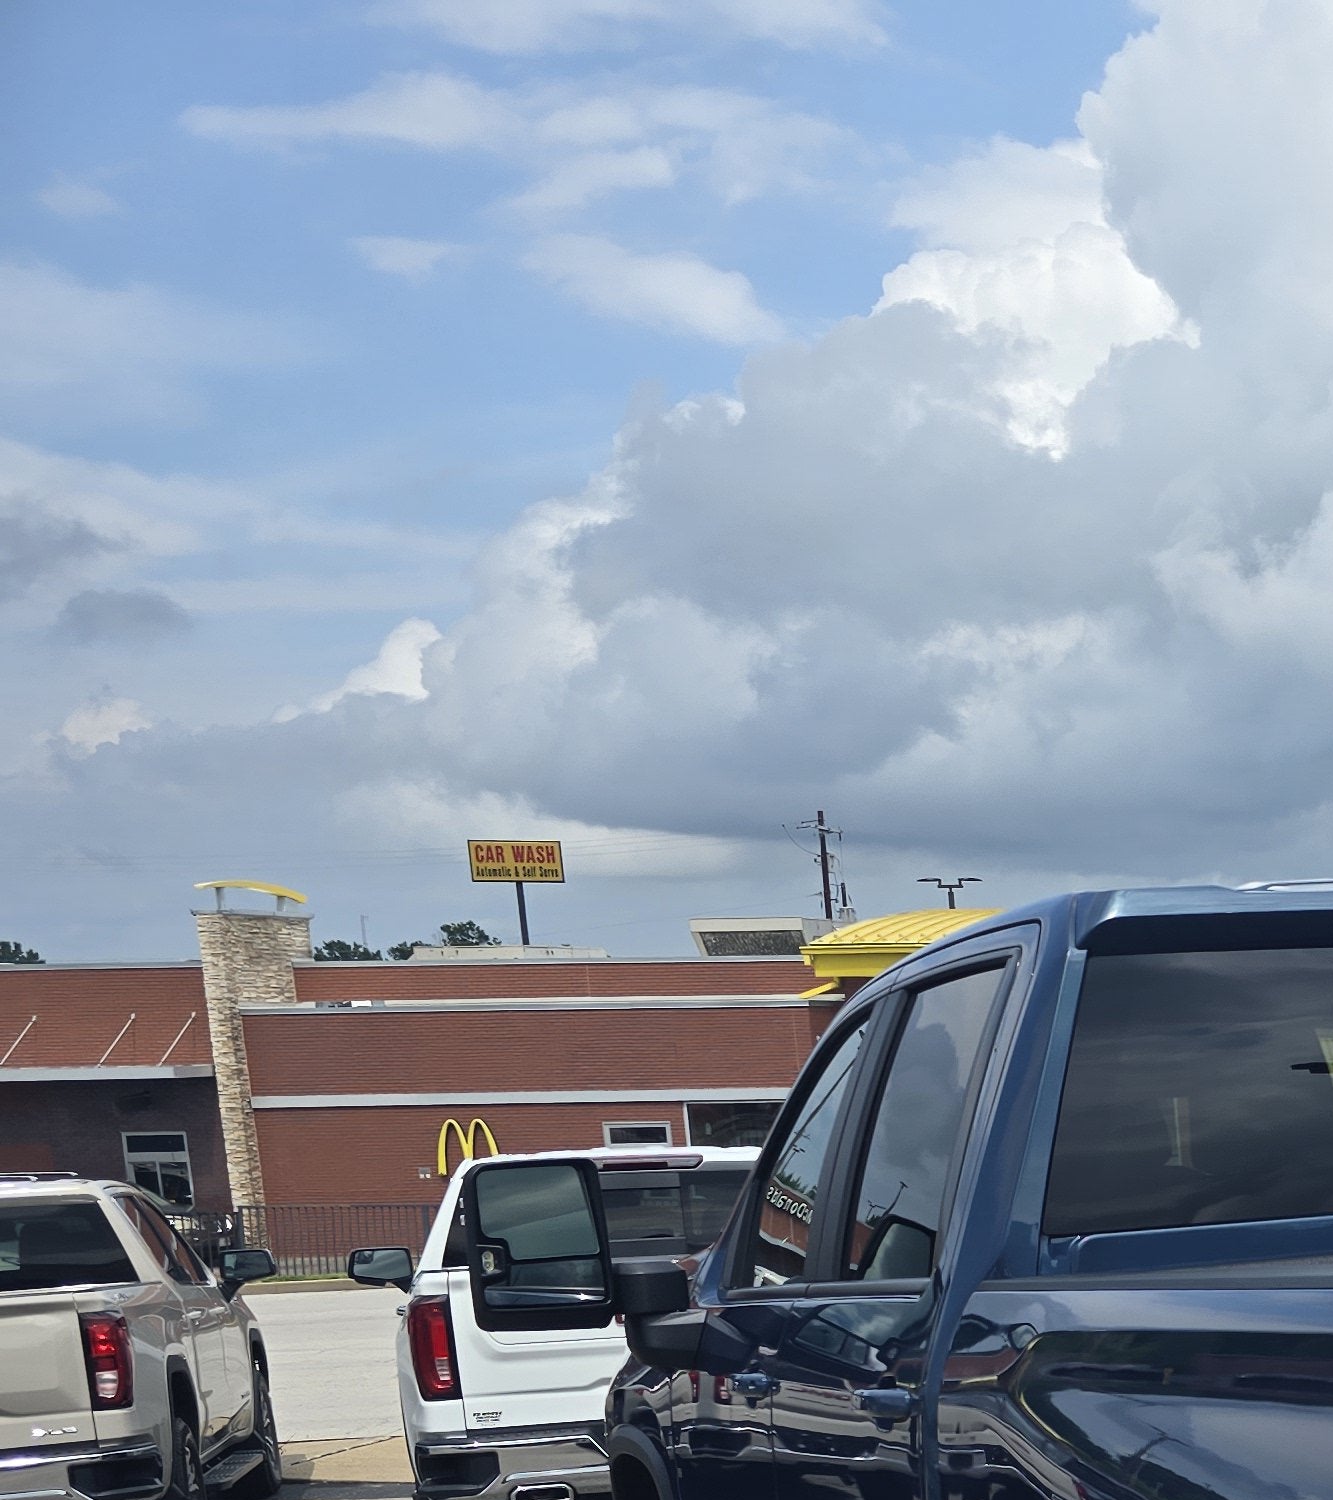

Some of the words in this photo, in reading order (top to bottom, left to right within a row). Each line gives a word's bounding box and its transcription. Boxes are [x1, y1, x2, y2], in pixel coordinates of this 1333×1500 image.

[474, 844, 505, 863] CAR
[511, 845, 556, 864] WASH
[476, 865, 512, 878] Automatic
[514, 866, 520, 877] &
[522, 866, 536, 878] Self
[539, 866, 559, 878] Serve
